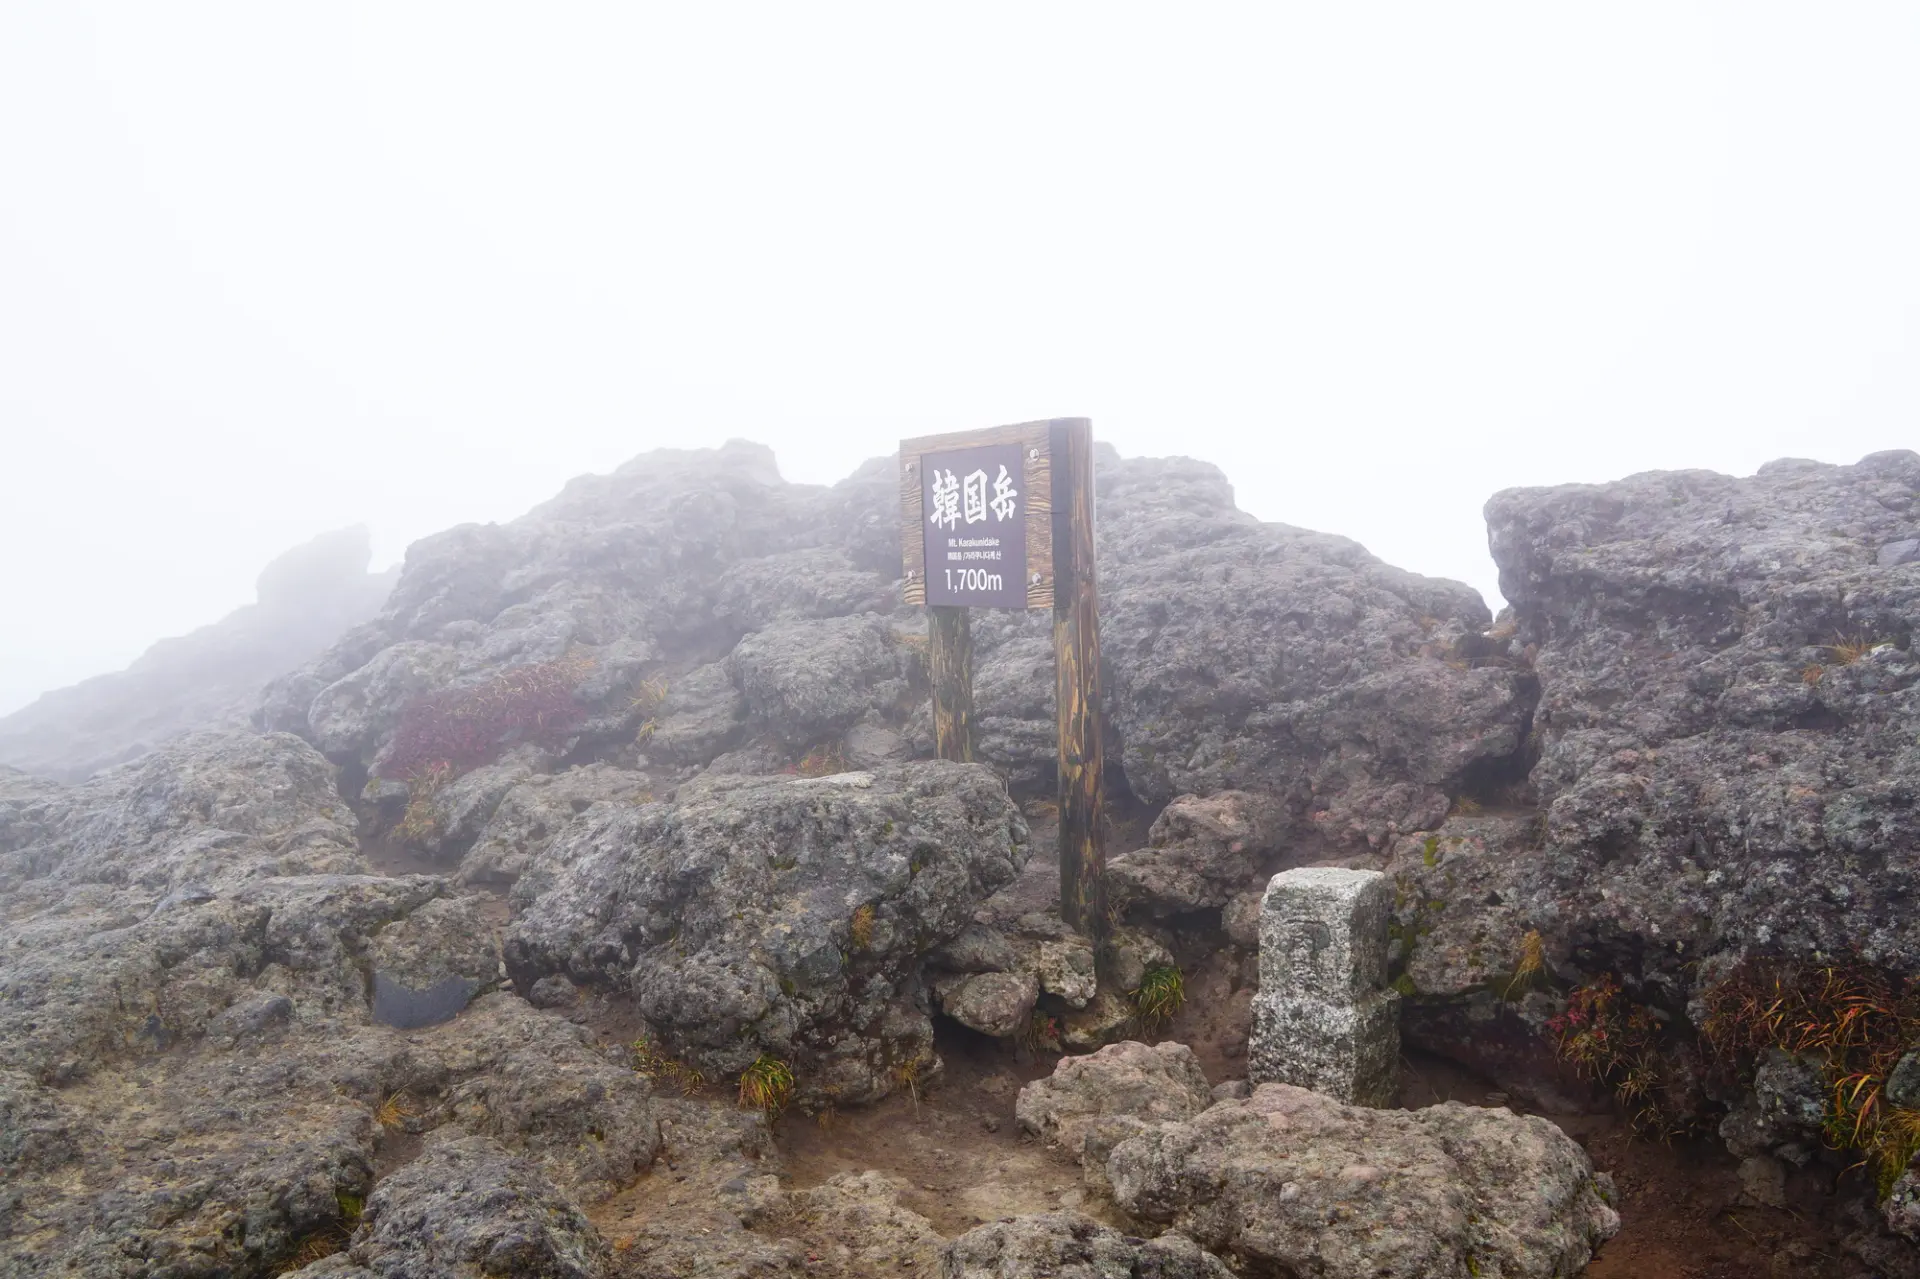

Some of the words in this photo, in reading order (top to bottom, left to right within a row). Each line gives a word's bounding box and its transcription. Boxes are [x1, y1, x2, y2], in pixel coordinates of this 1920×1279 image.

[930, 464, 1017, 531] 韓国岳
[948, 538, 958, 547] Mt.
[958, 537, 1000, 547] Karakunidake
[945, 569, 1002, 593] 1,700m
